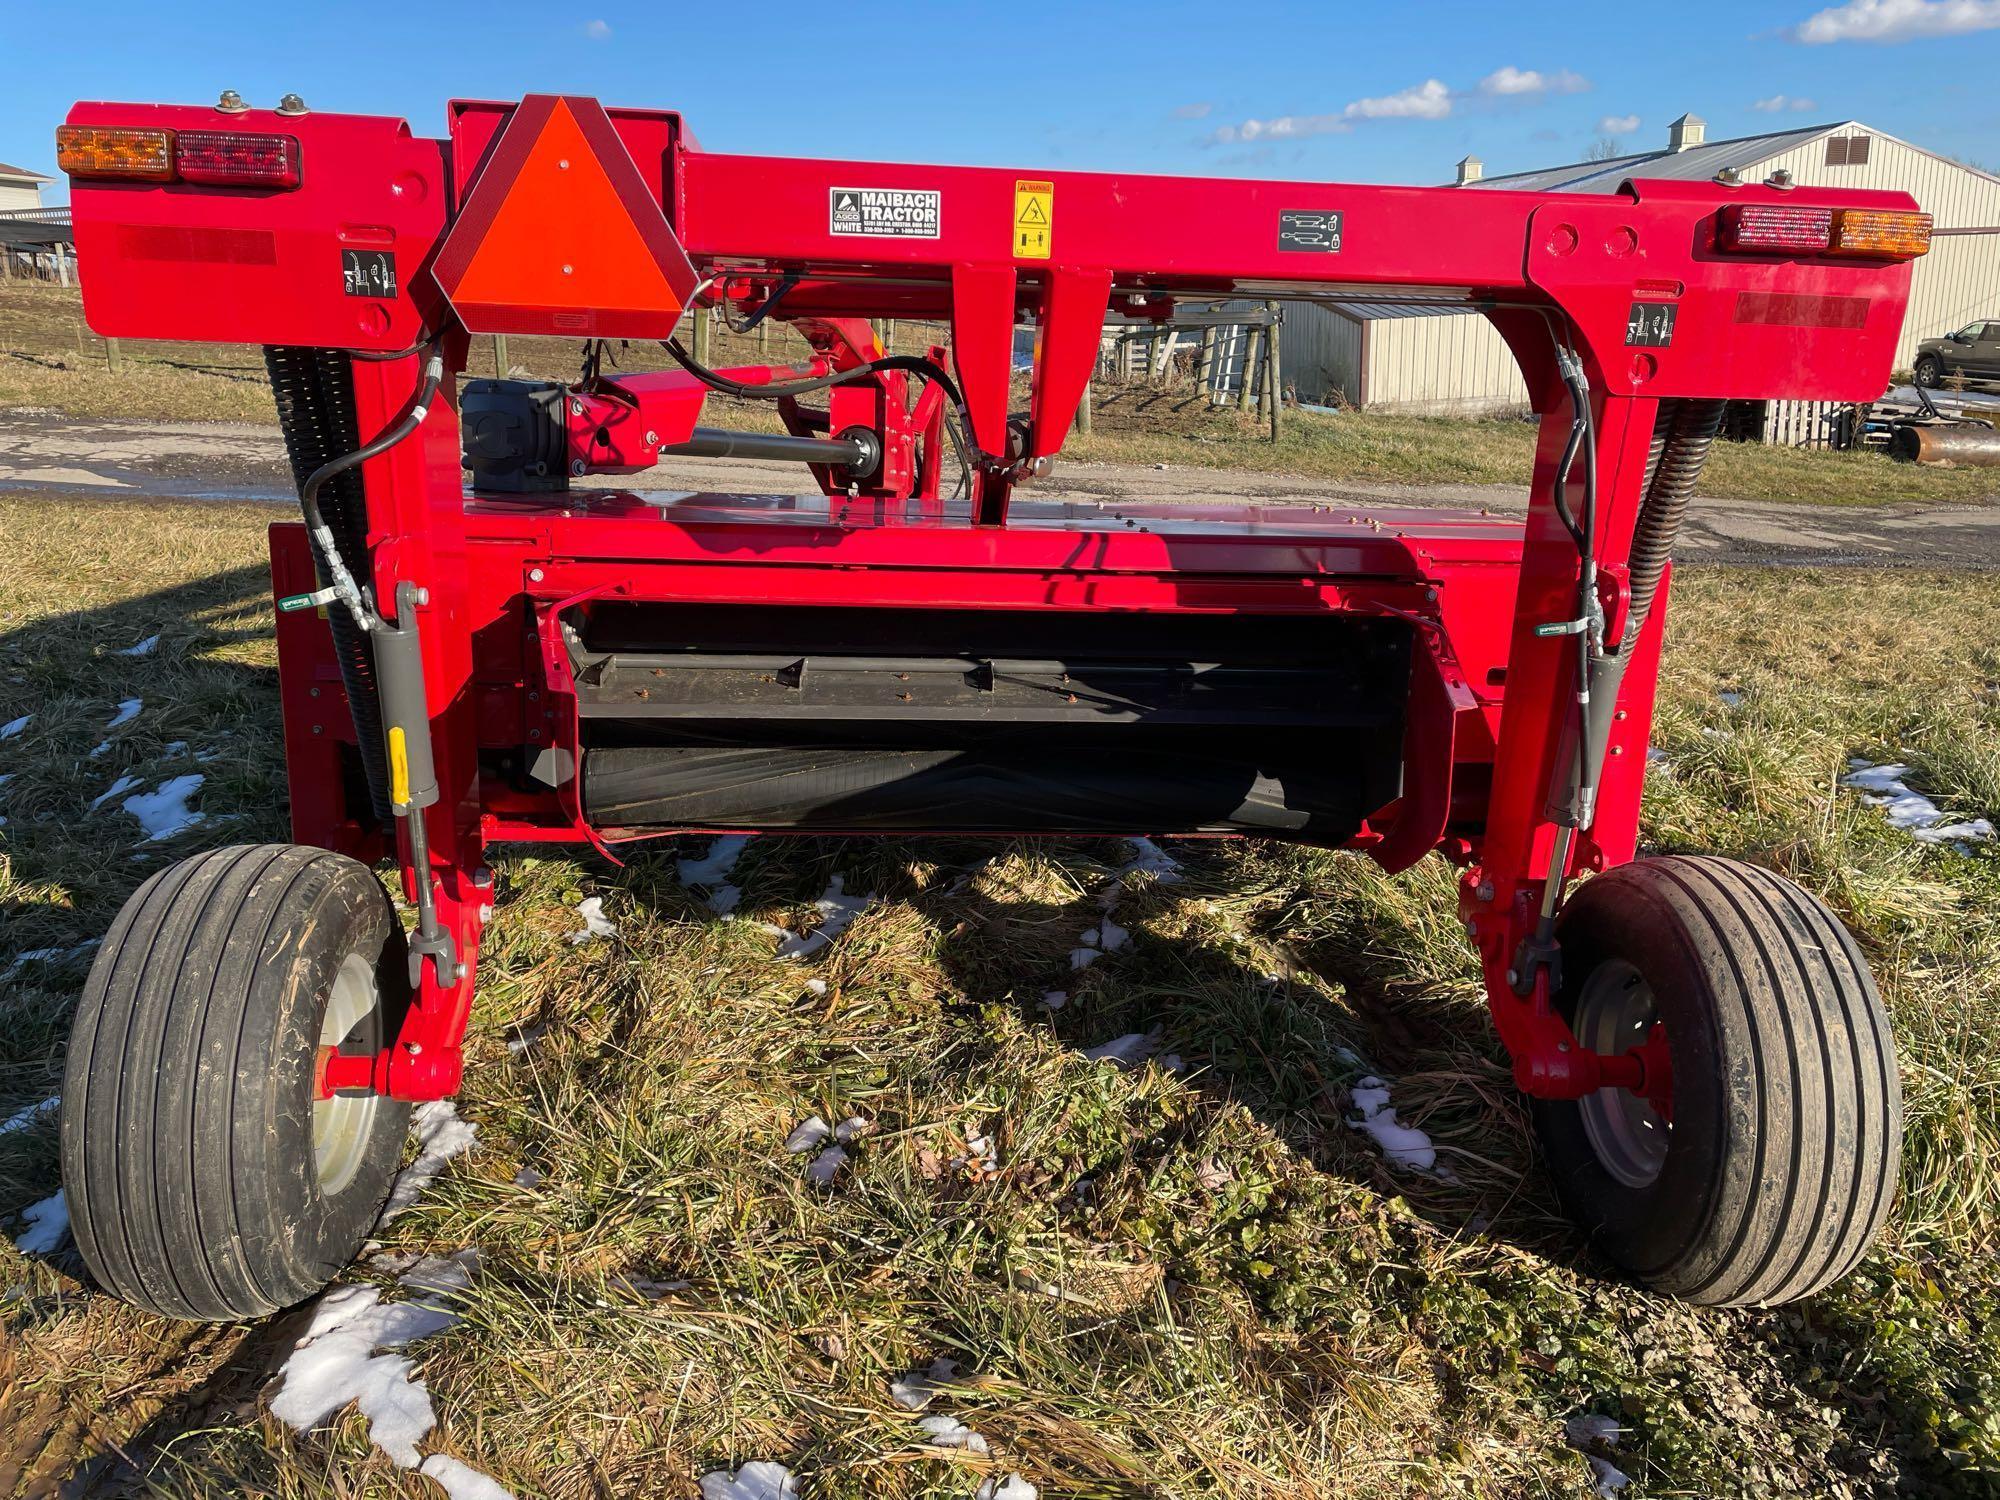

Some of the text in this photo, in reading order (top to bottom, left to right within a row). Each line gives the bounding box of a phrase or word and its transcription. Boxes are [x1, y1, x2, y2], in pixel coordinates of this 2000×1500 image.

[862, 192, 936, 208] MAIBACH
[862, 207, 935, 222] TRACTOR
[833, 221, 862, 232] WHITE
